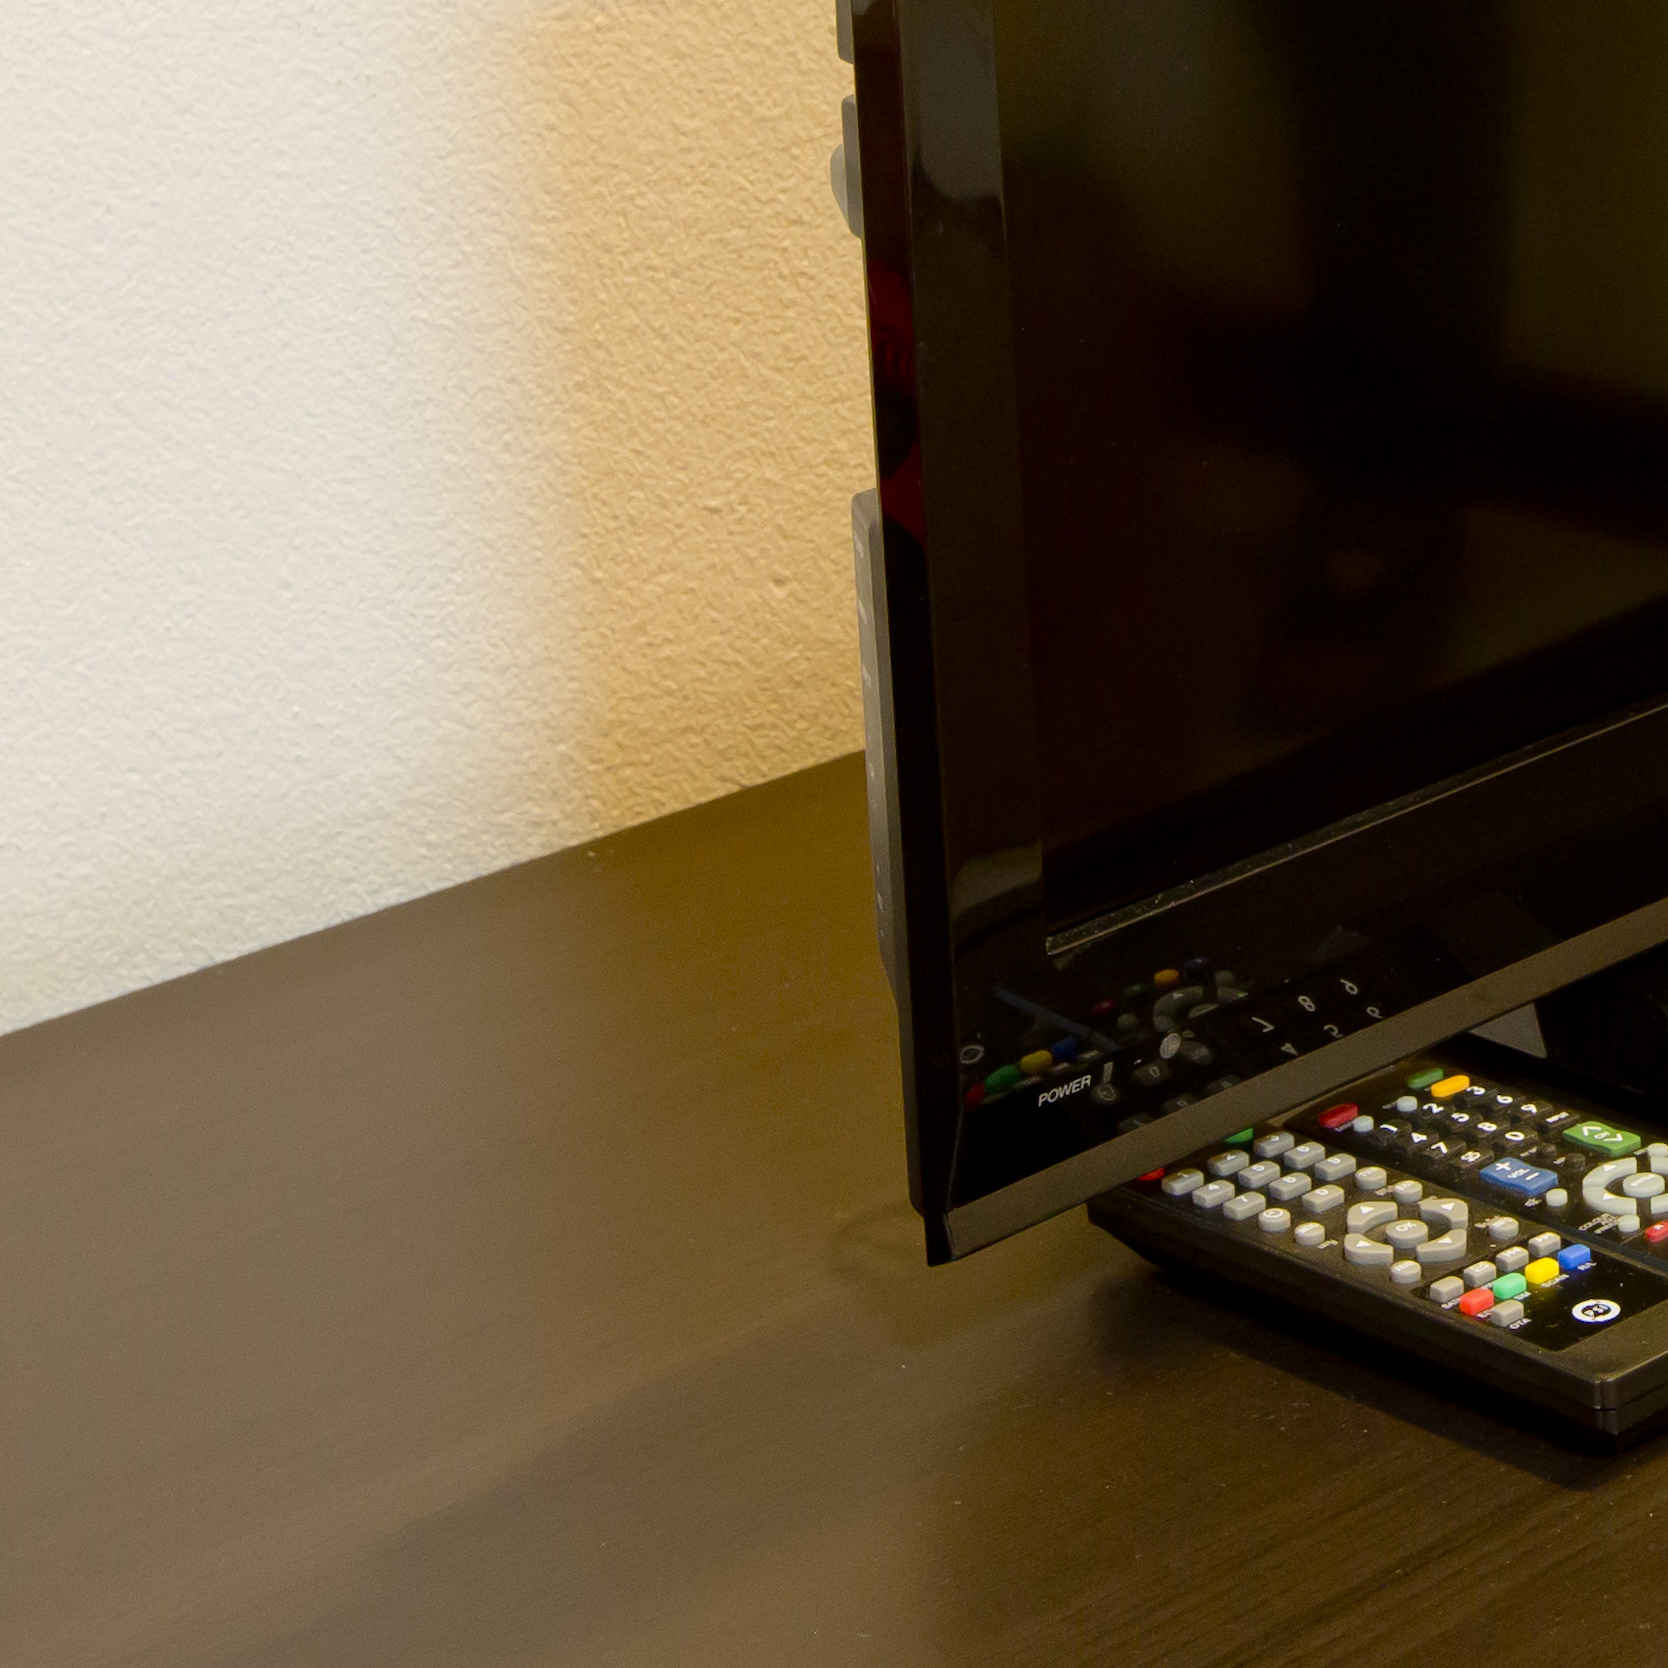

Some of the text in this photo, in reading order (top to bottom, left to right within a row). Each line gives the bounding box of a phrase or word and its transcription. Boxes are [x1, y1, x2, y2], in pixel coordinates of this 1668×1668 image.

[1037, 1074, 1093, 1108] POWER
[1466, 1085, 1487, 1096] 3
[1496, 1094, 1514, 1105] 6
[1422, 1102, 1445, 1114] 2
[1520, 1103, 1538, 1115] 9
[1450, 1112, 1471, 1123] 5
[1379, 1123, 1399, 1133] 1
[1477, 1121, 1498, 1133] 8
[1411, 1132, 1428, 1144] 4
[1504, 1131, 1526, 1142] 0
[1430, 1141, 1449, 1155] 7
[1395, 1221, 1418, 1233] OK
